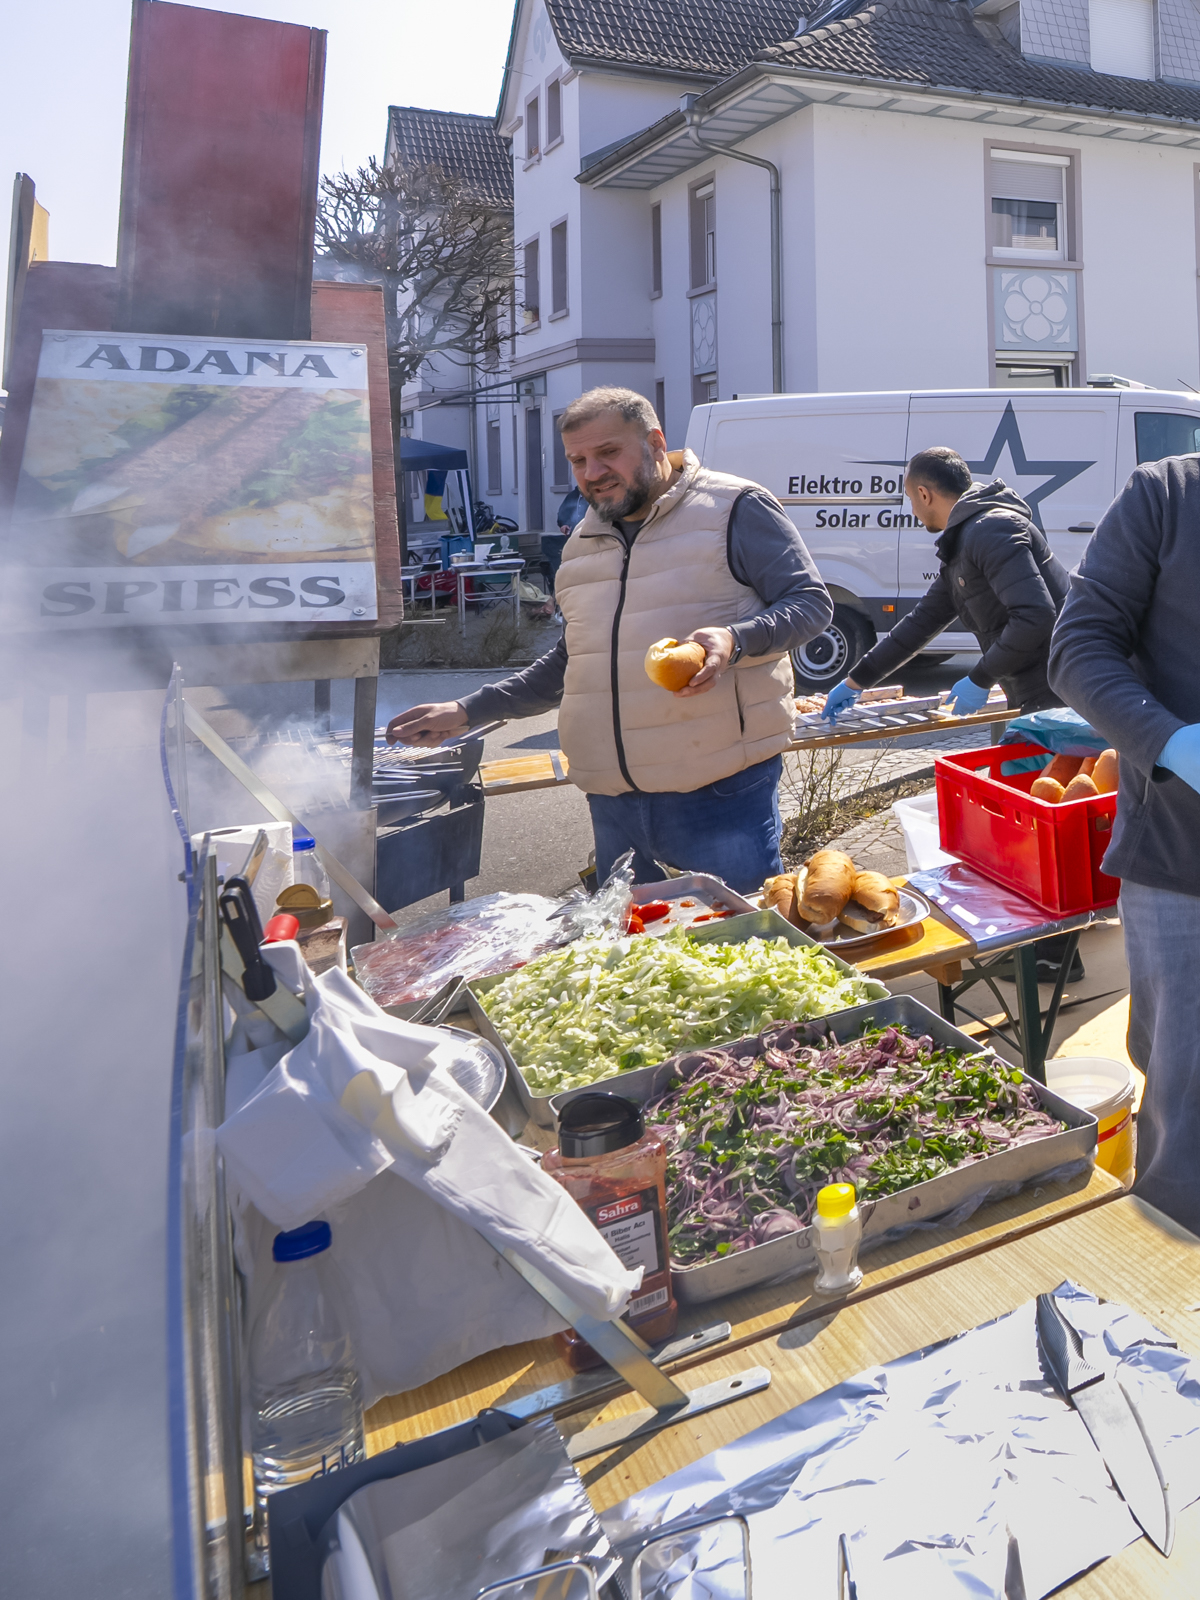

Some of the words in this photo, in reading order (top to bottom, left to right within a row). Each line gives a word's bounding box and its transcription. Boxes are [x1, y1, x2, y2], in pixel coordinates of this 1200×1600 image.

[76, 343, 339, 379] ADANA
[788, 475, 863, 494] Elektro
[815, 508, 870, 528] Solar
[40, 576, 346, 617] SPIESS
[598, 1201, 639, 1221] Sahra
[611, 1225, 631, 1237] Biber
